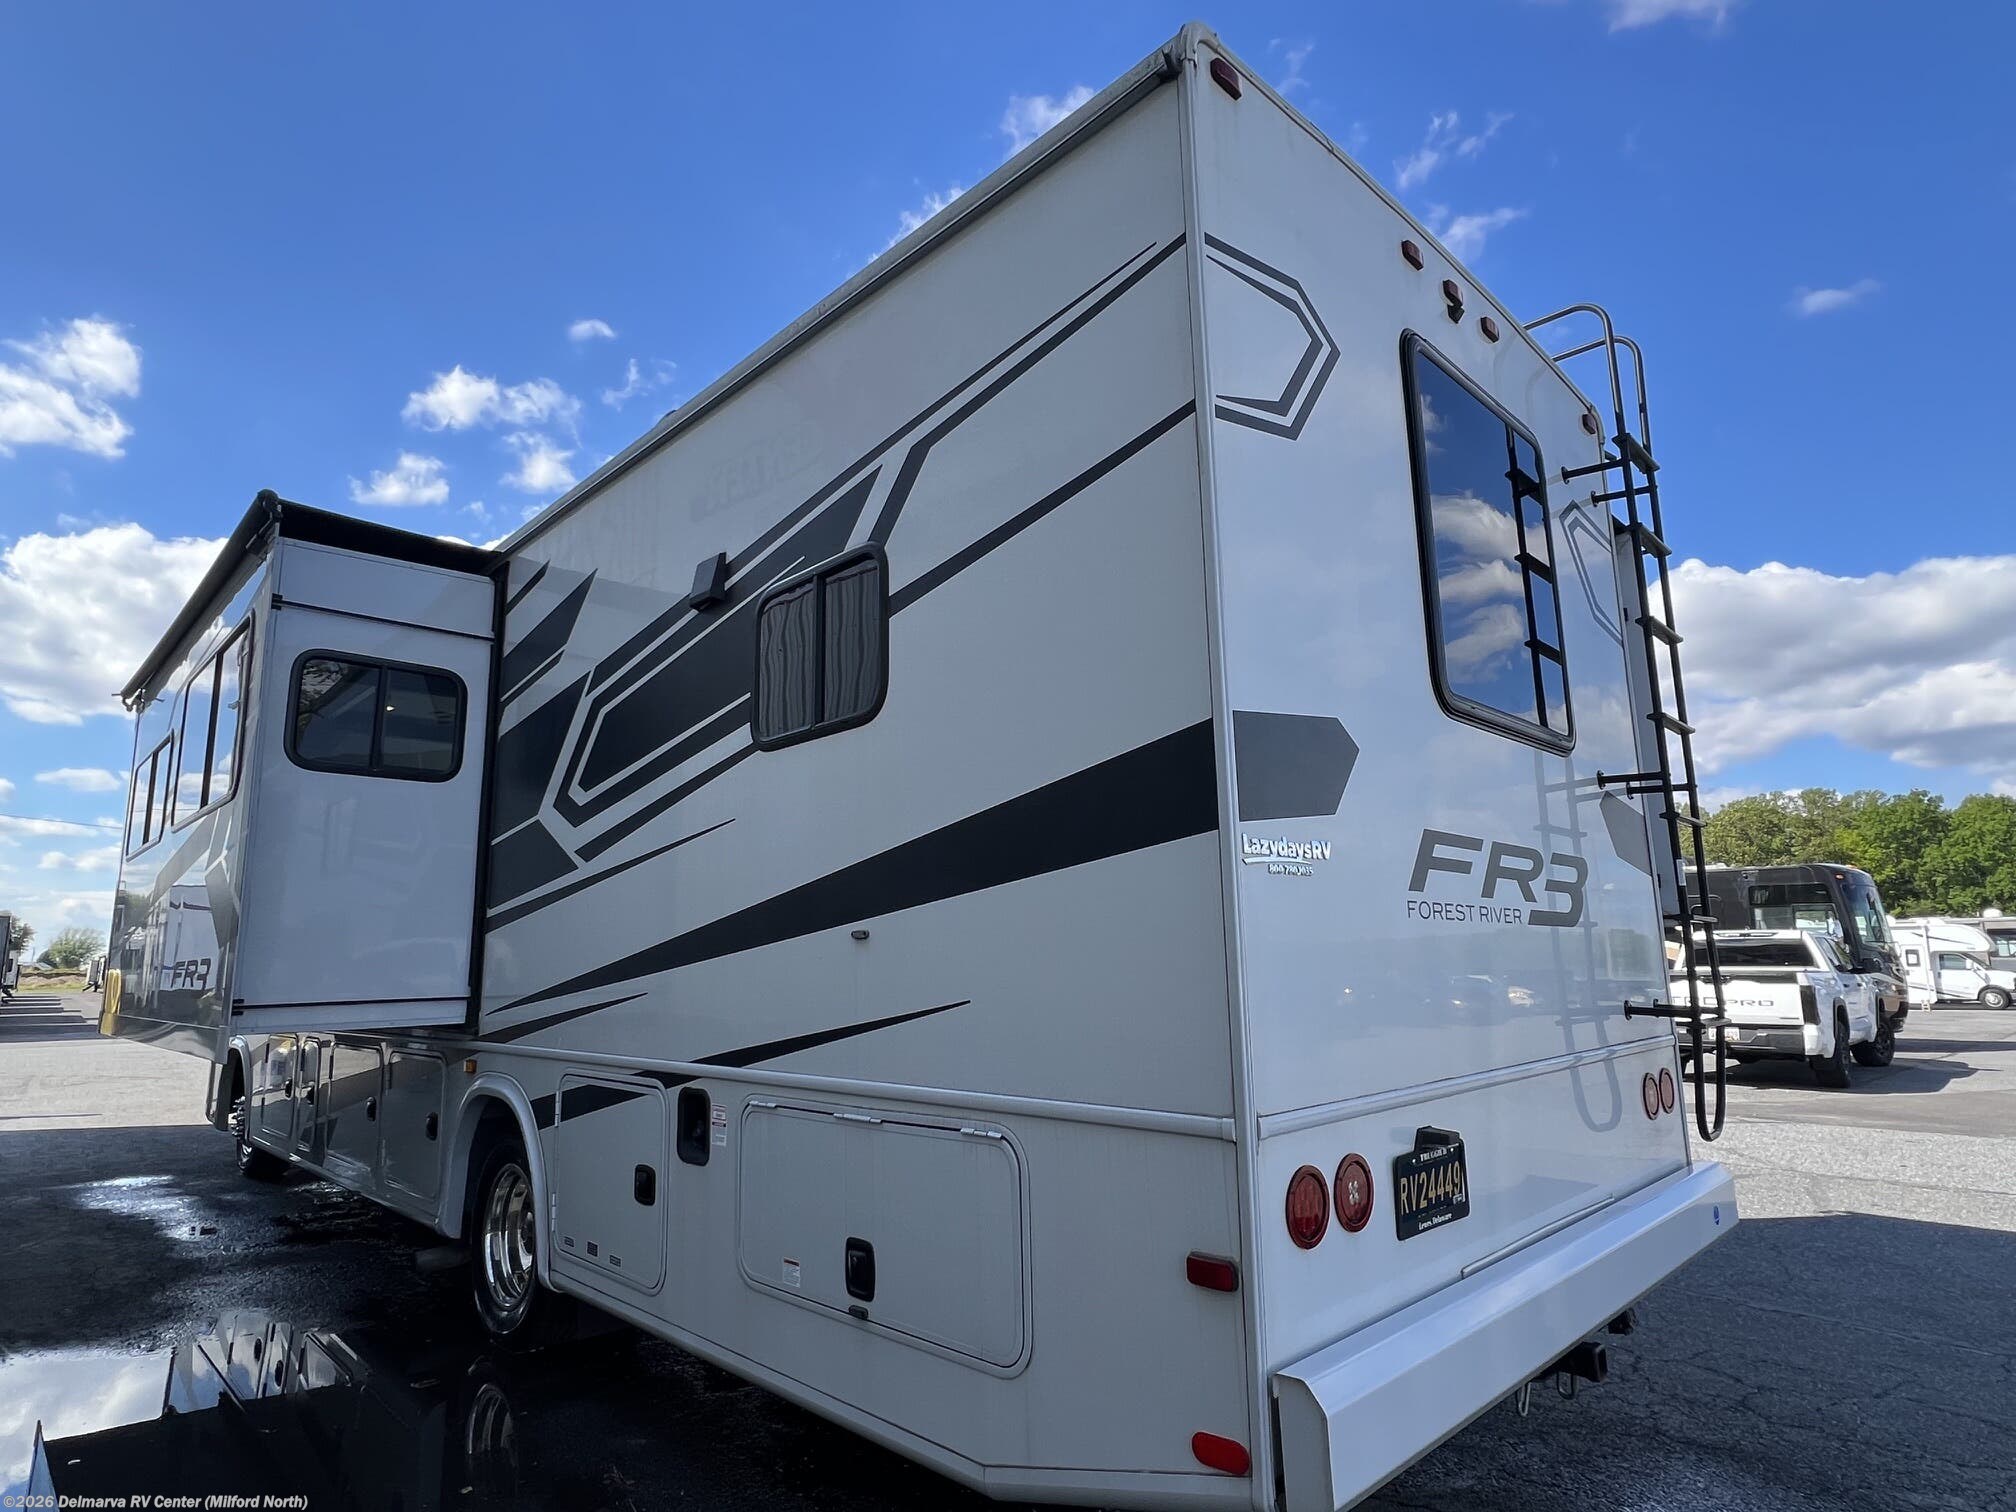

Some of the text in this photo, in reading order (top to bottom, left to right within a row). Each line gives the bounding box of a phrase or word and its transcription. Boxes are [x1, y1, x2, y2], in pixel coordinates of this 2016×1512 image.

[1242, 832, 1332, 861] LazydaysRV
[1408, 828, 1589, 928] FR3
[1407, 900, 1523, 925] FOREST RIVER
[1400, 1160, 1462, 1216] RV24449
